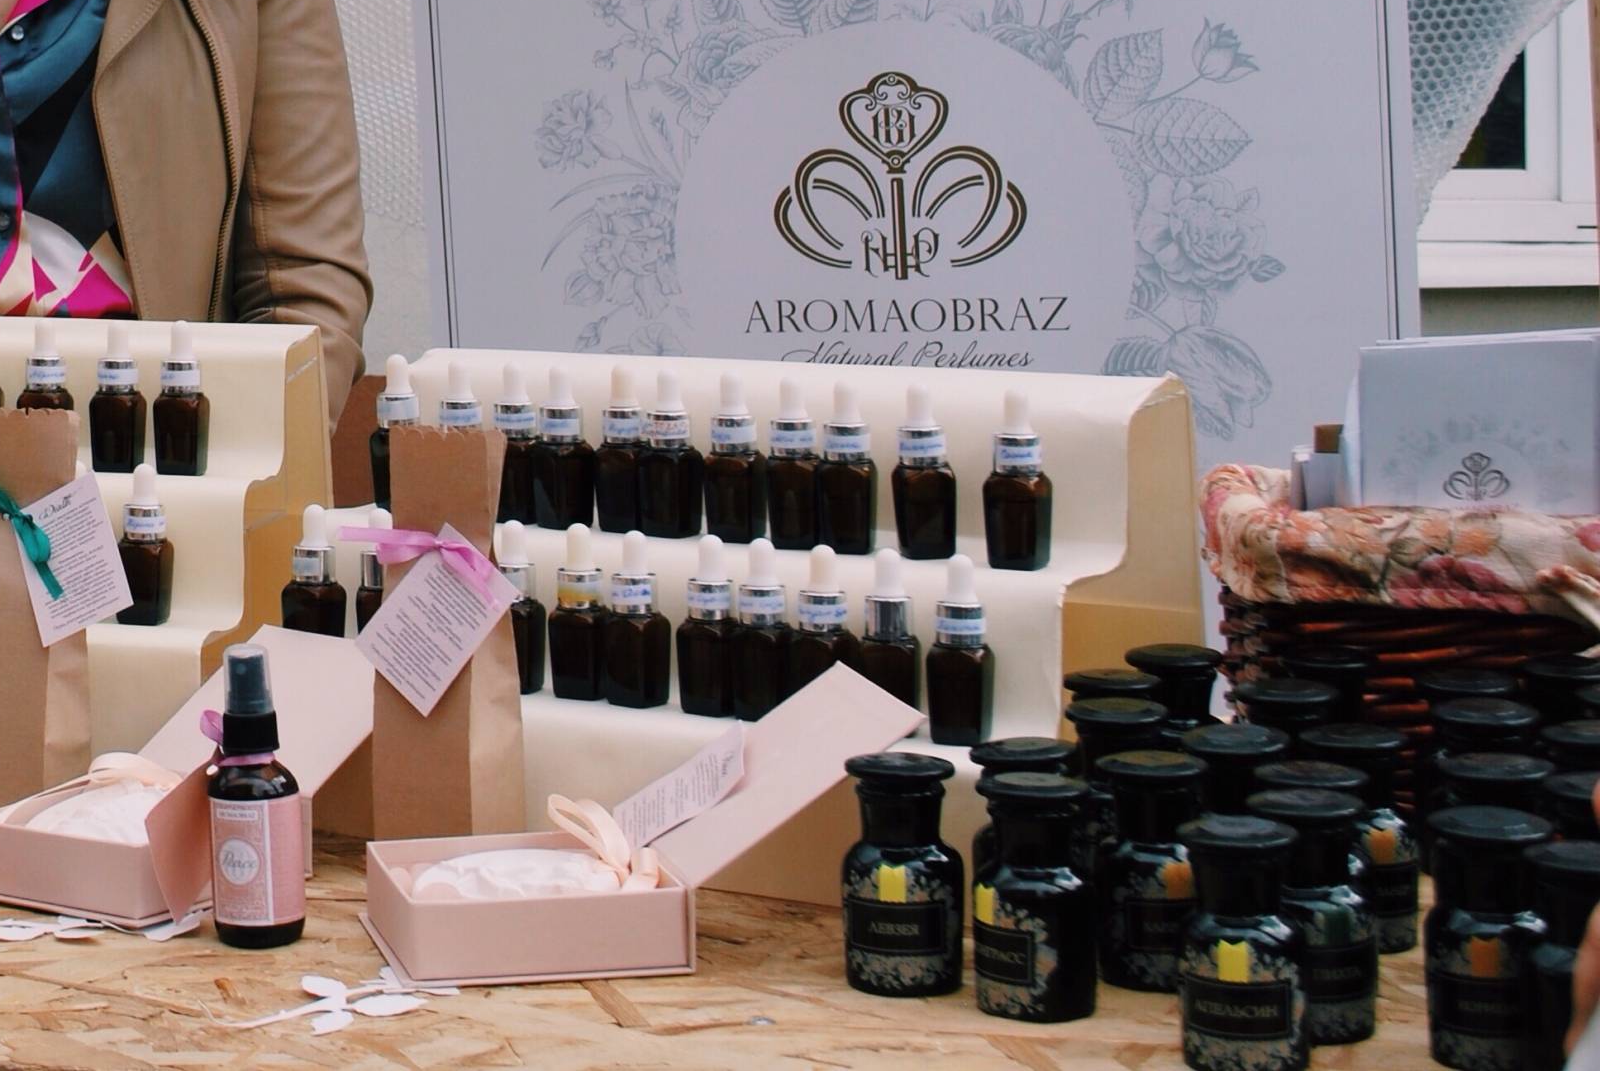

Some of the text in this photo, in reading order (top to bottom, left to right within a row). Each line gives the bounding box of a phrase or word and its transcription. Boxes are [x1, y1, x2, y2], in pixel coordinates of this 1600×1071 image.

[744, 296, 1072, 334] AROMAOBRAZ
[781, 340, 1035, 369] Natural Perfumes
[1194, 997, 1280, 1020] АПЕЛЬСИН
